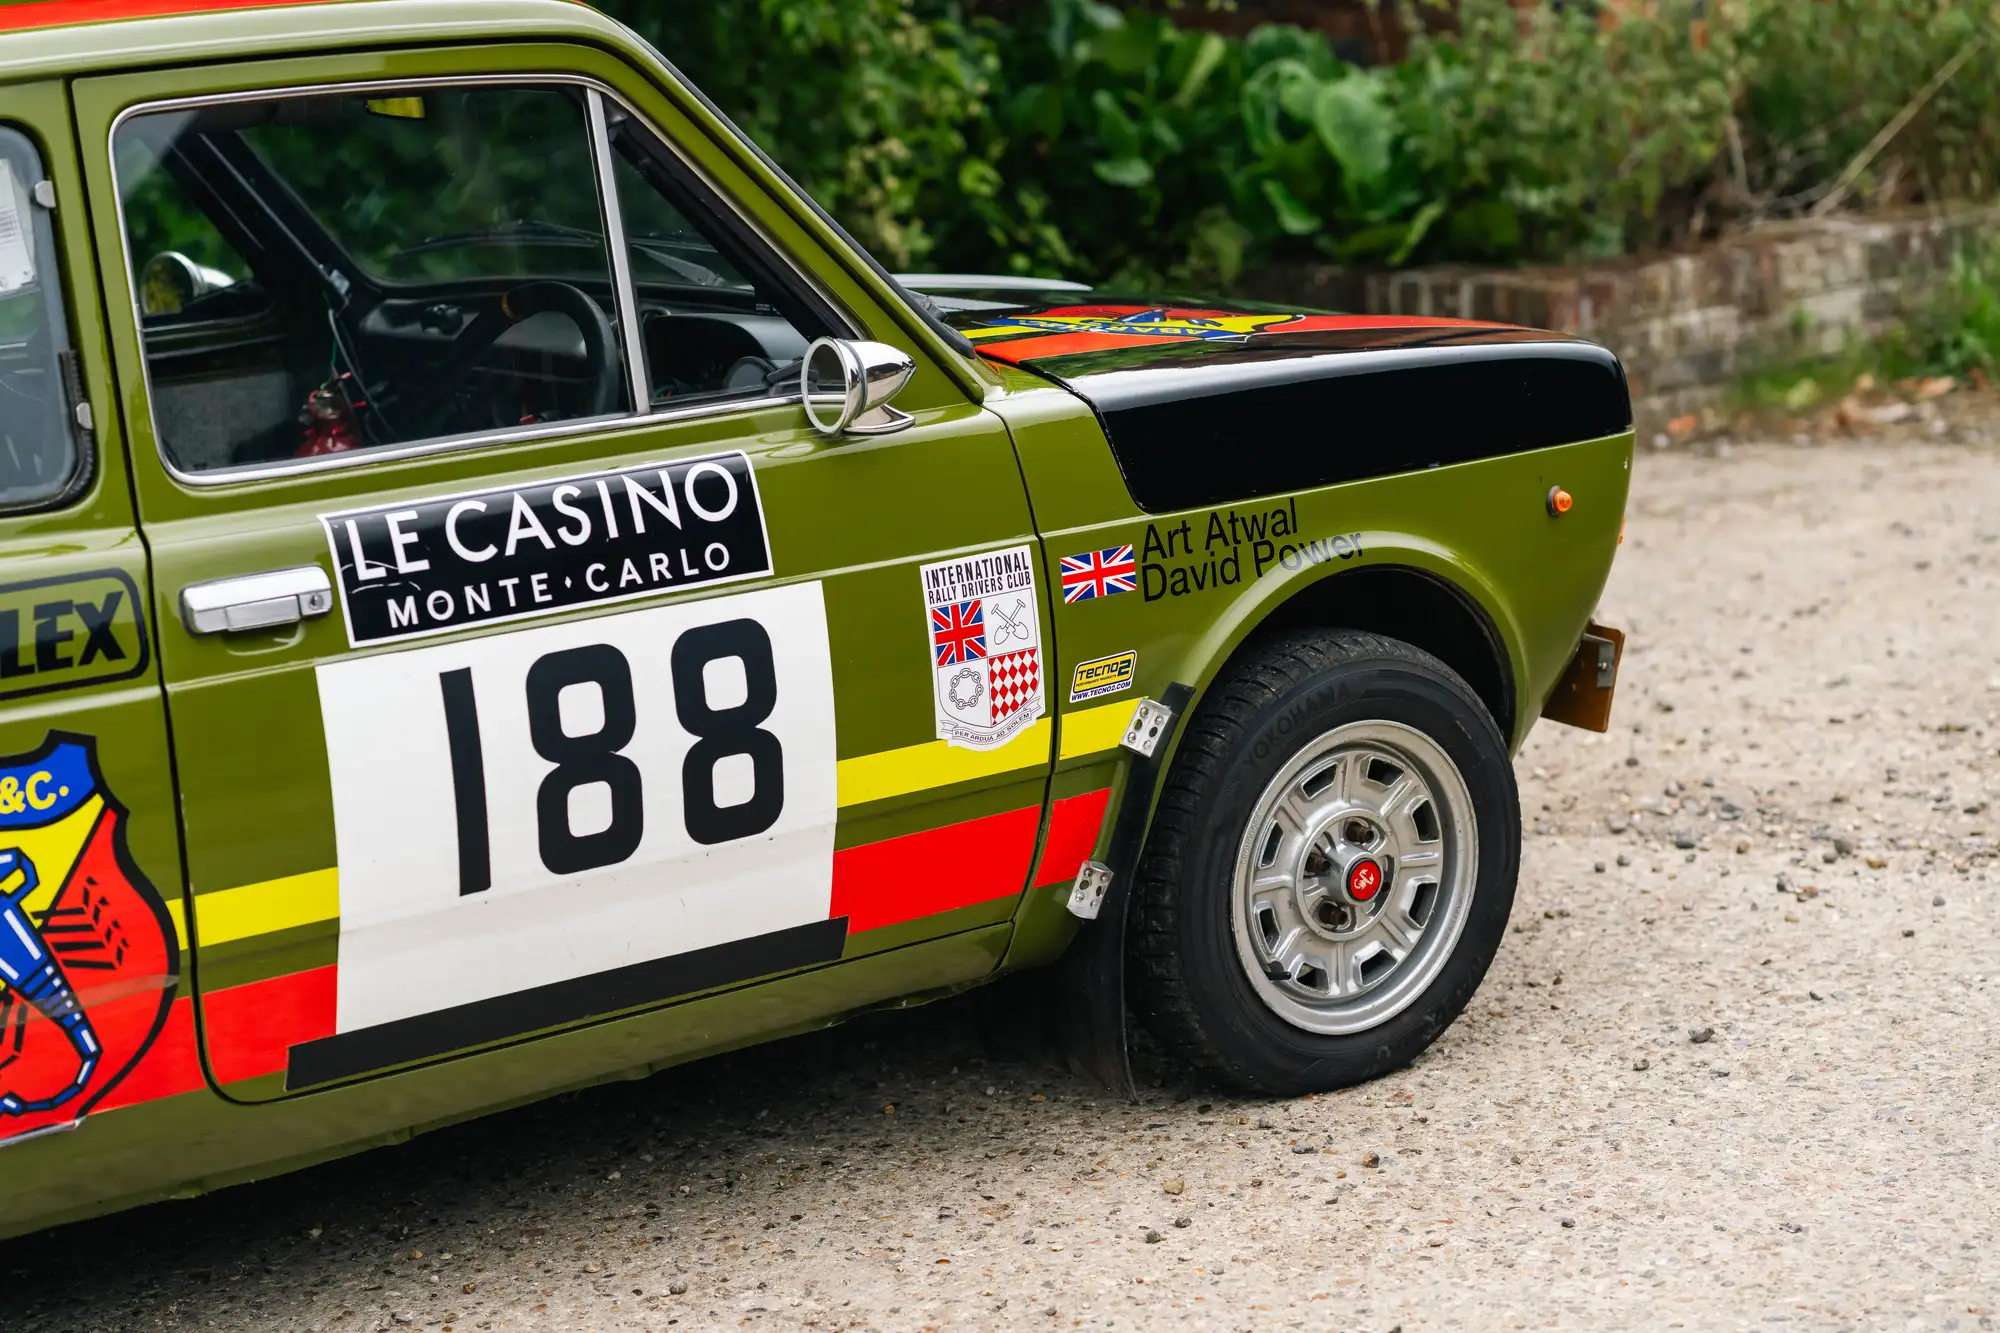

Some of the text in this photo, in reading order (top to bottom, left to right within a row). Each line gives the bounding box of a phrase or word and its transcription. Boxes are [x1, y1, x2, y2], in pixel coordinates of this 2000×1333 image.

[345, 462, 738, 581] LE CASINO
[1141, 497, 1298, 563] Art Atwal
[387, 542, 730, 629] MONTE CARLO
[925, 552, 1029, 589] INTERNATIONAL
[928, 571, 1031, 604] RALLY DRIVERS CLUB
[1141, 532, 1363, 602] David Power
[954, 730, 969, 738] PER
[1007, 712, 1030, 731] SOLEM
[1071, 681, 1131, 701] WWW.TECNO2.COM
[1242, 681, 1351, 768] YOKOHAMA
[439, 618, 784, 896] 188
